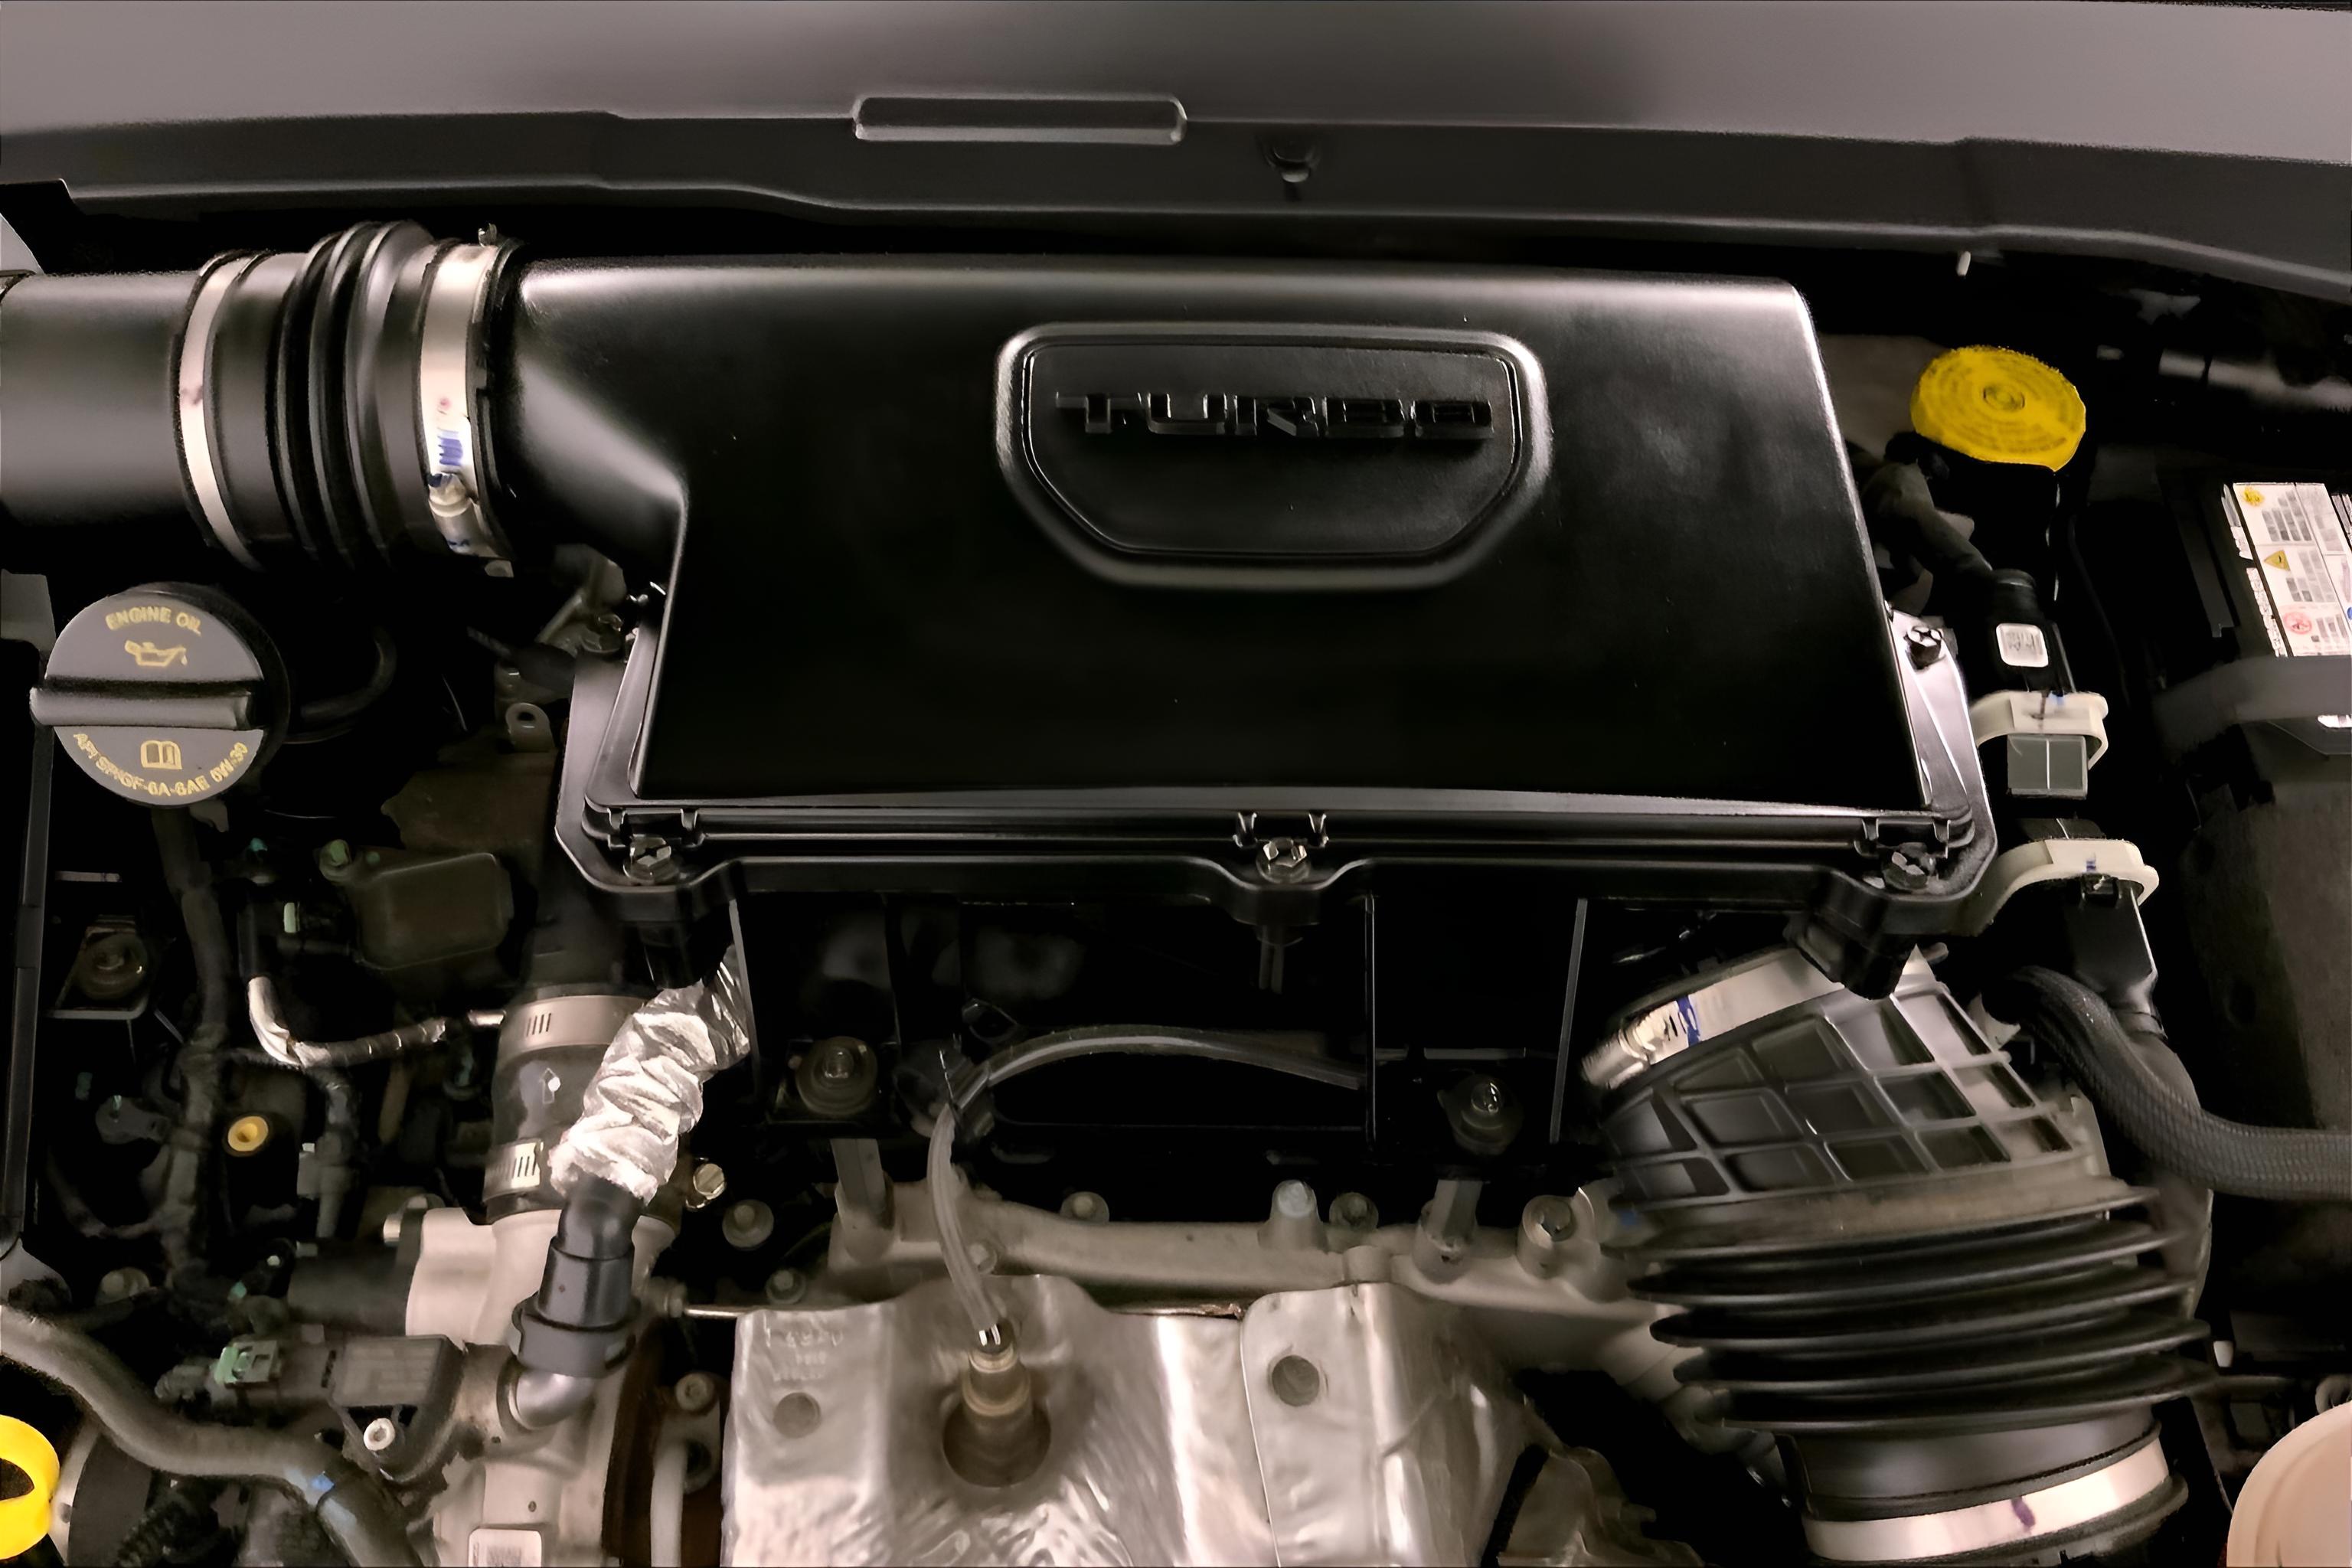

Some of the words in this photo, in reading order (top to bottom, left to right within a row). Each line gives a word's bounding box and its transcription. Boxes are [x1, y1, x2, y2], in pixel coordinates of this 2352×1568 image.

[1056, 391, 1495, 439] TURBO
[105, 606, 172, 631] ENGINE
[176, 612, 201, 636] OIL
